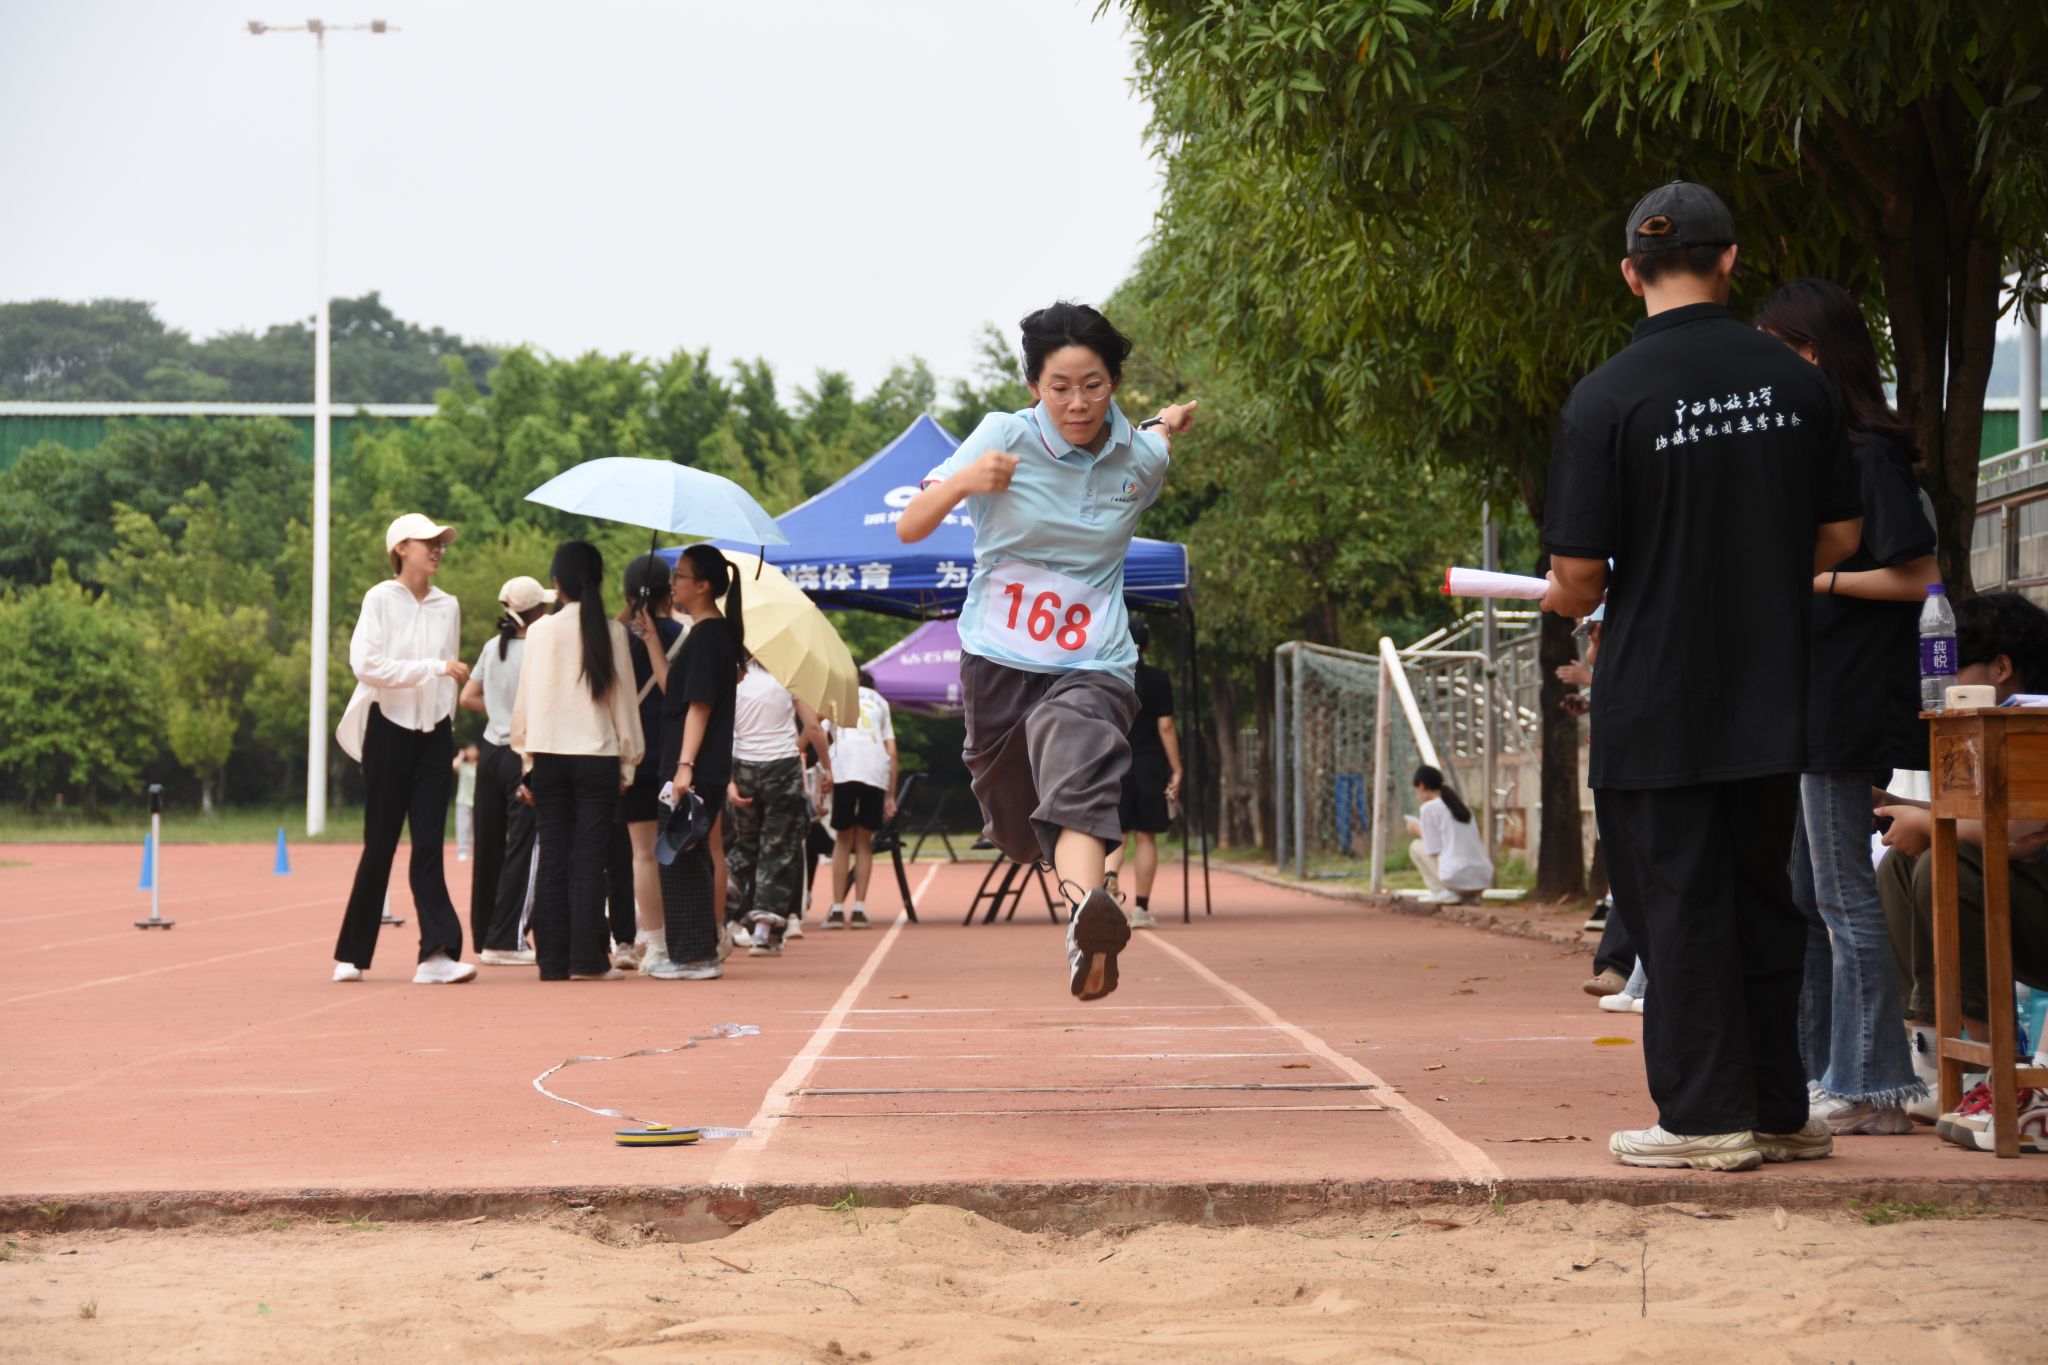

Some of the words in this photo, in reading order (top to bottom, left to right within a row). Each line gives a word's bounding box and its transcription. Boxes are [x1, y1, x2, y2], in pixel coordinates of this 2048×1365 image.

[1675, 386, 1772, 425] 广西民族大学
[936, 561, 979, 588] 为
[1004, 582, 1092, 651] 168
[1933, 640, 1948, 668] 纯悦
